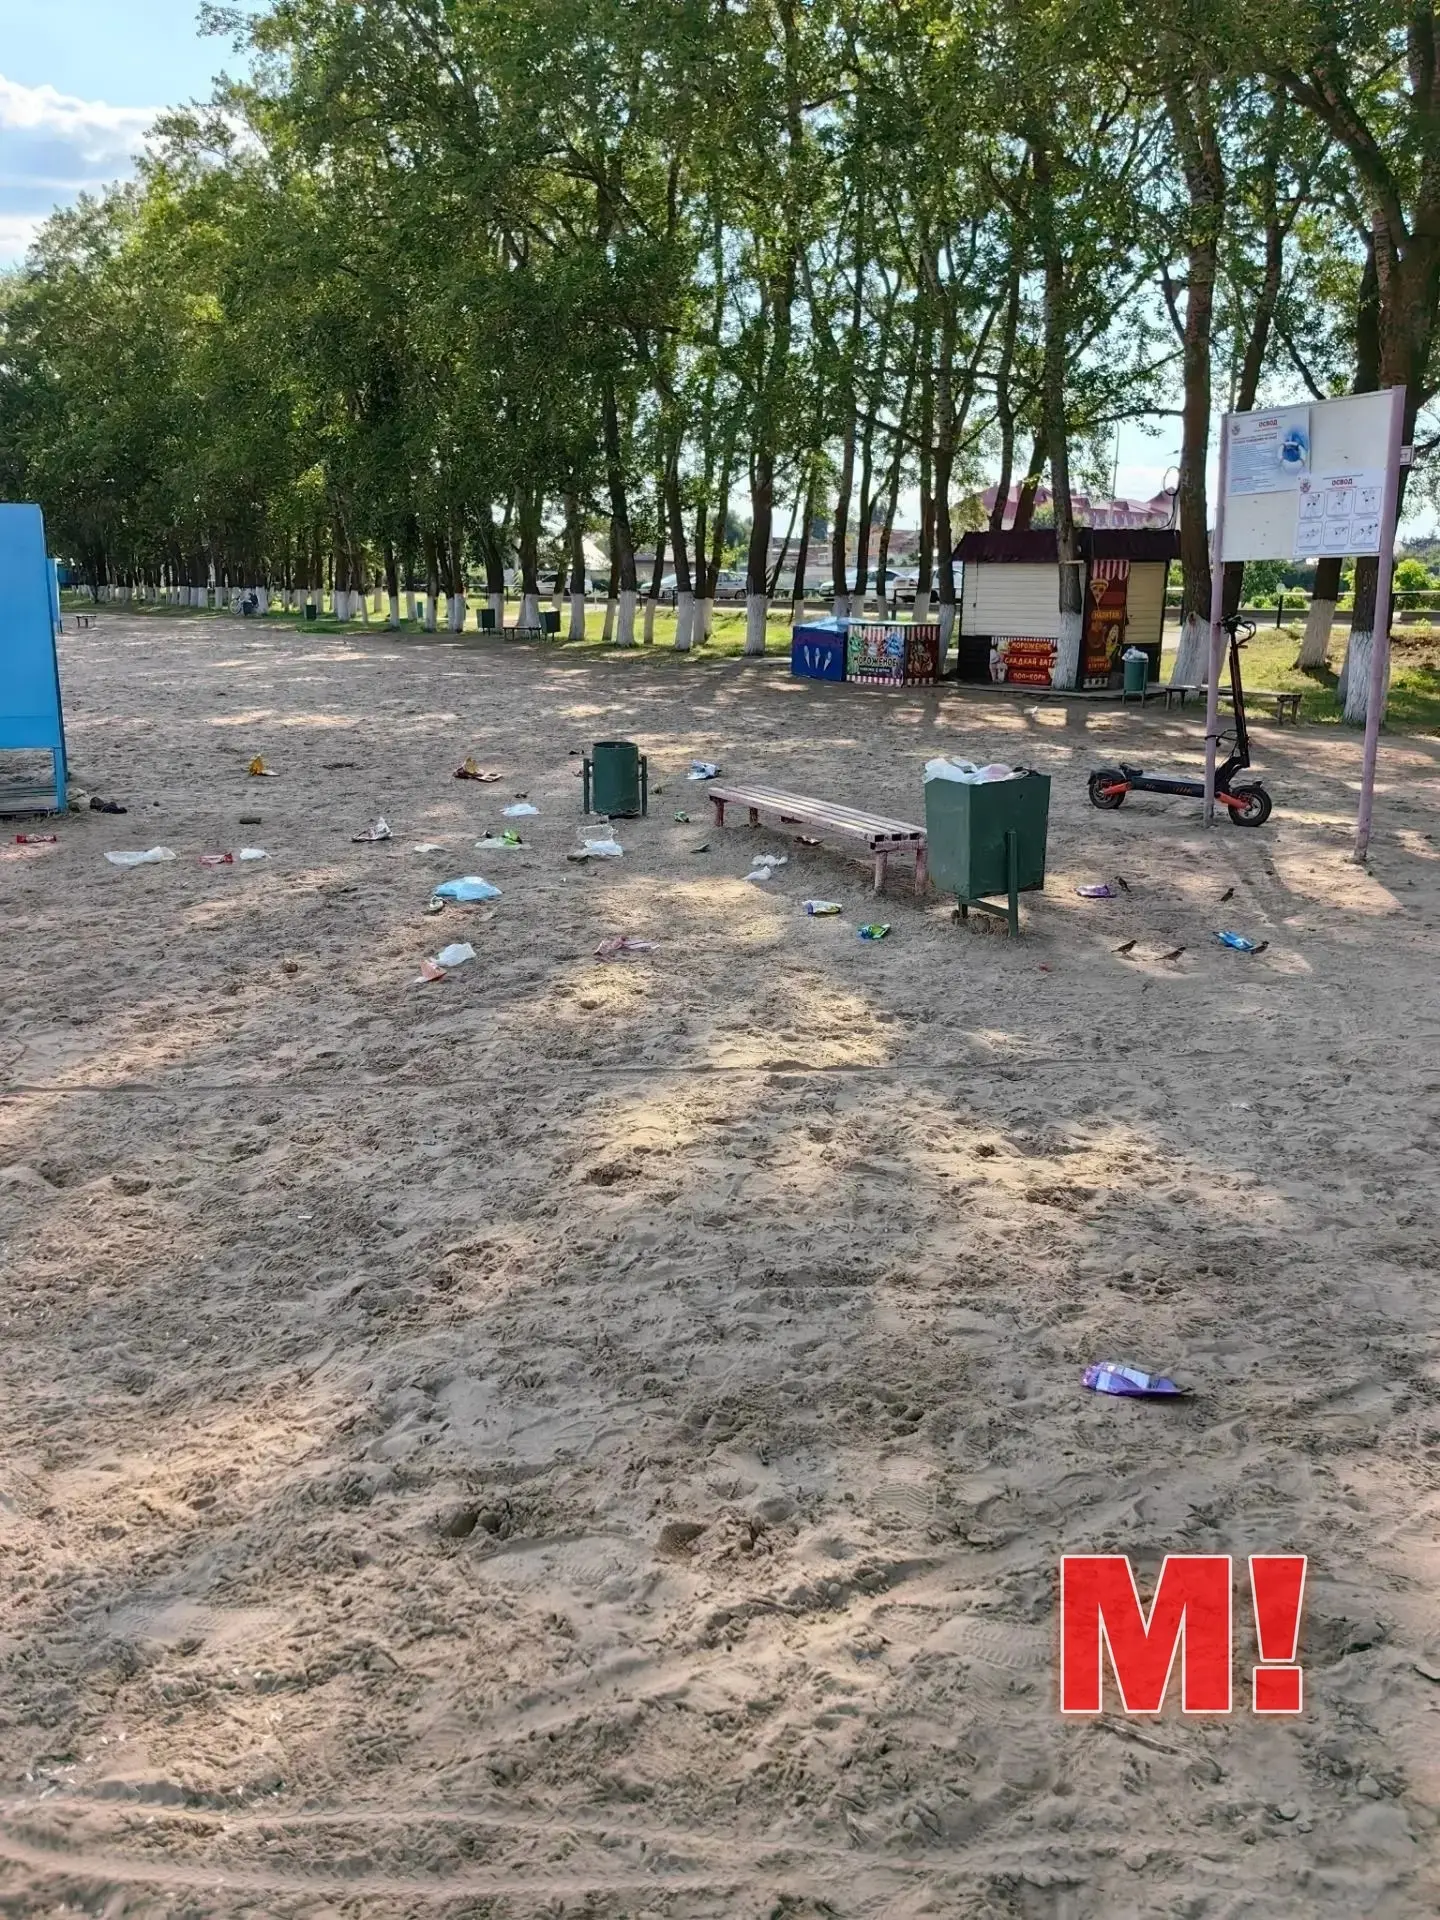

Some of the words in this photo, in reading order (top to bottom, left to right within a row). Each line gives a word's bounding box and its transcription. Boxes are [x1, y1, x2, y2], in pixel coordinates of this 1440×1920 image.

[1331, 478, 1353, 486] ОСВОД
[1011, 642, 1051, 651] МОРОЖЕНОЕ
[853, 656, 897, 667] МОРОЖЕНОЕ
